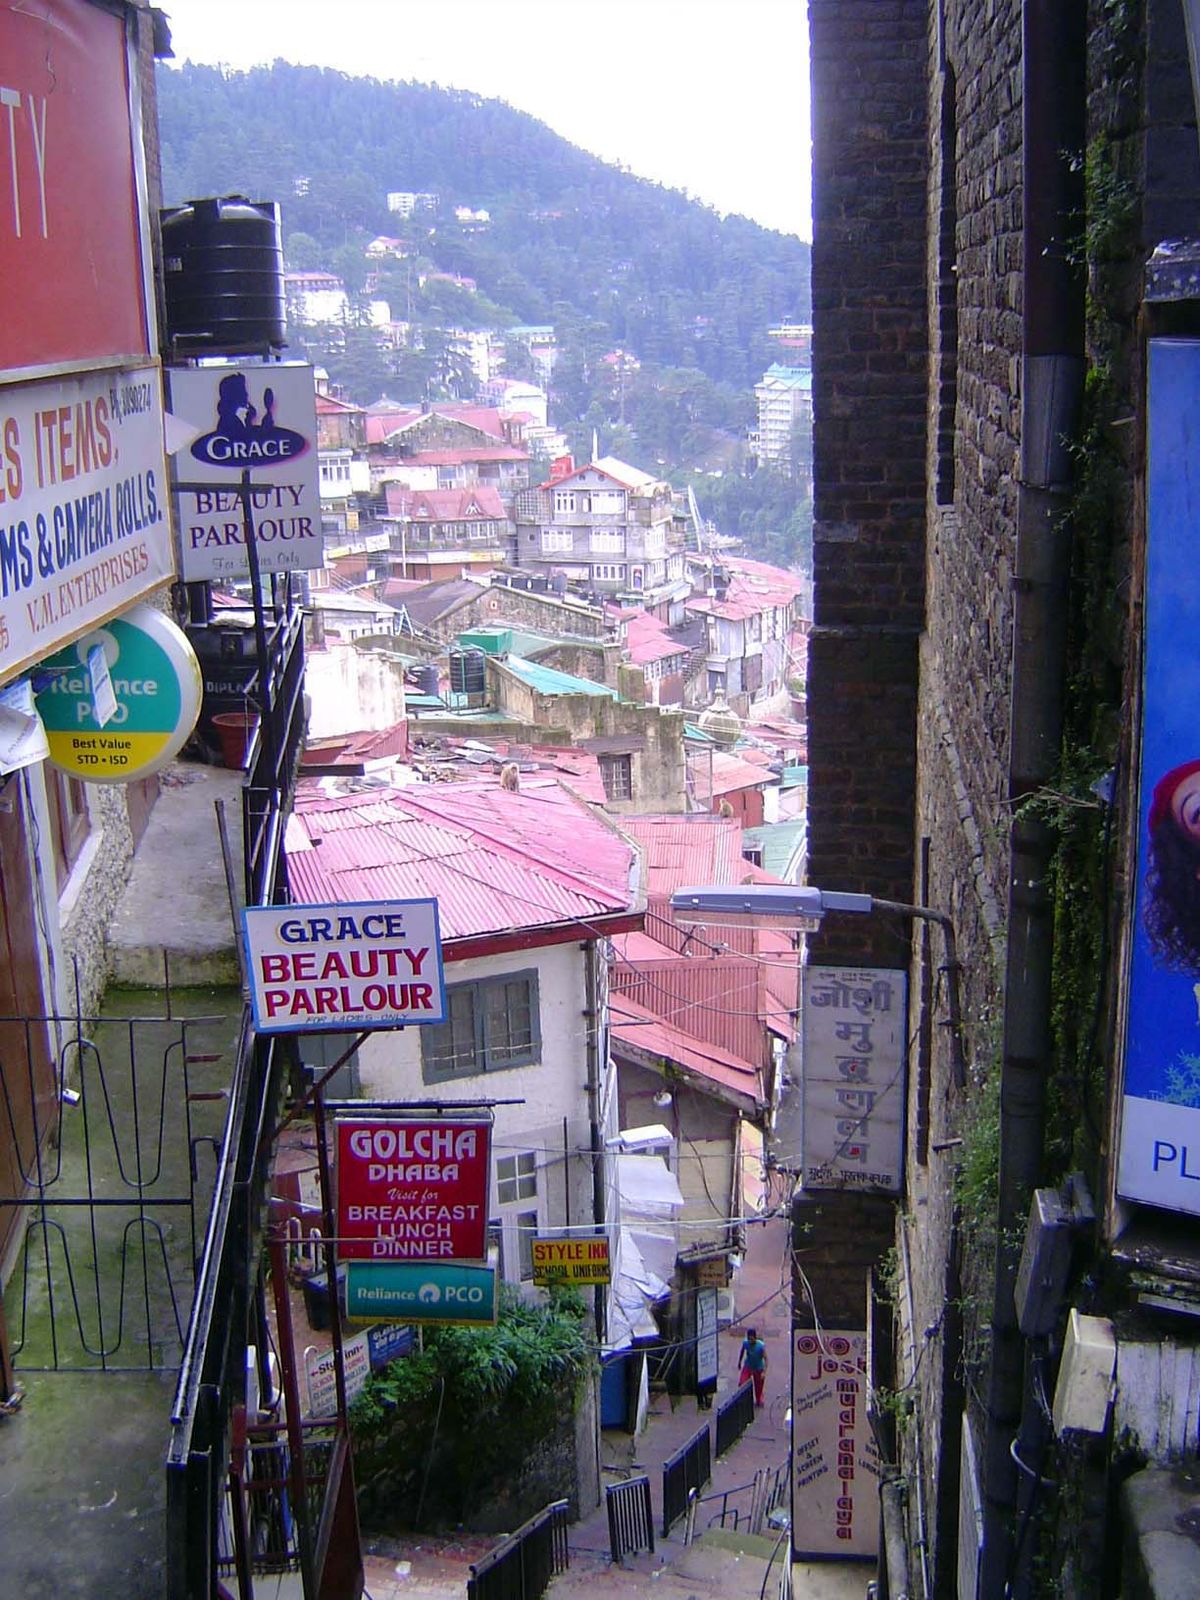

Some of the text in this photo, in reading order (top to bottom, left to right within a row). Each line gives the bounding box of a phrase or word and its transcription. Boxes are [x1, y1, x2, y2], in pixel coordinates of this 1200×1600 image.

[0, 416, 23, 500] S
[36, 512, 55, 579] &
[54, 487, 113, 571] CAMERA
[58, 543, 149, 616] ENTERPRISES
[72, 738, 131, 749] Best Value
[77, 755, 128, 764] STD ISD
[279, 914, 407, 943] GRACE
[261, 948, 429, 984] BEAUTY
[264, 983, 433, 1018] PARLOUR
[350, 1130, 476, 1161] GOLCHA
[368, 1164, 459, 1182] DHABA
[388, 1188, 439, 1207] Visit for
[349, 1205, 479, 1220] BREAKFAST
[377, 1223, 450, 1238] LUNCH
[372, 1241, 454, 1255] DINNER
[535, 1243, 608, 1260] STYLE INN
[357, 1286, 483, 1301] Reliance PCO
